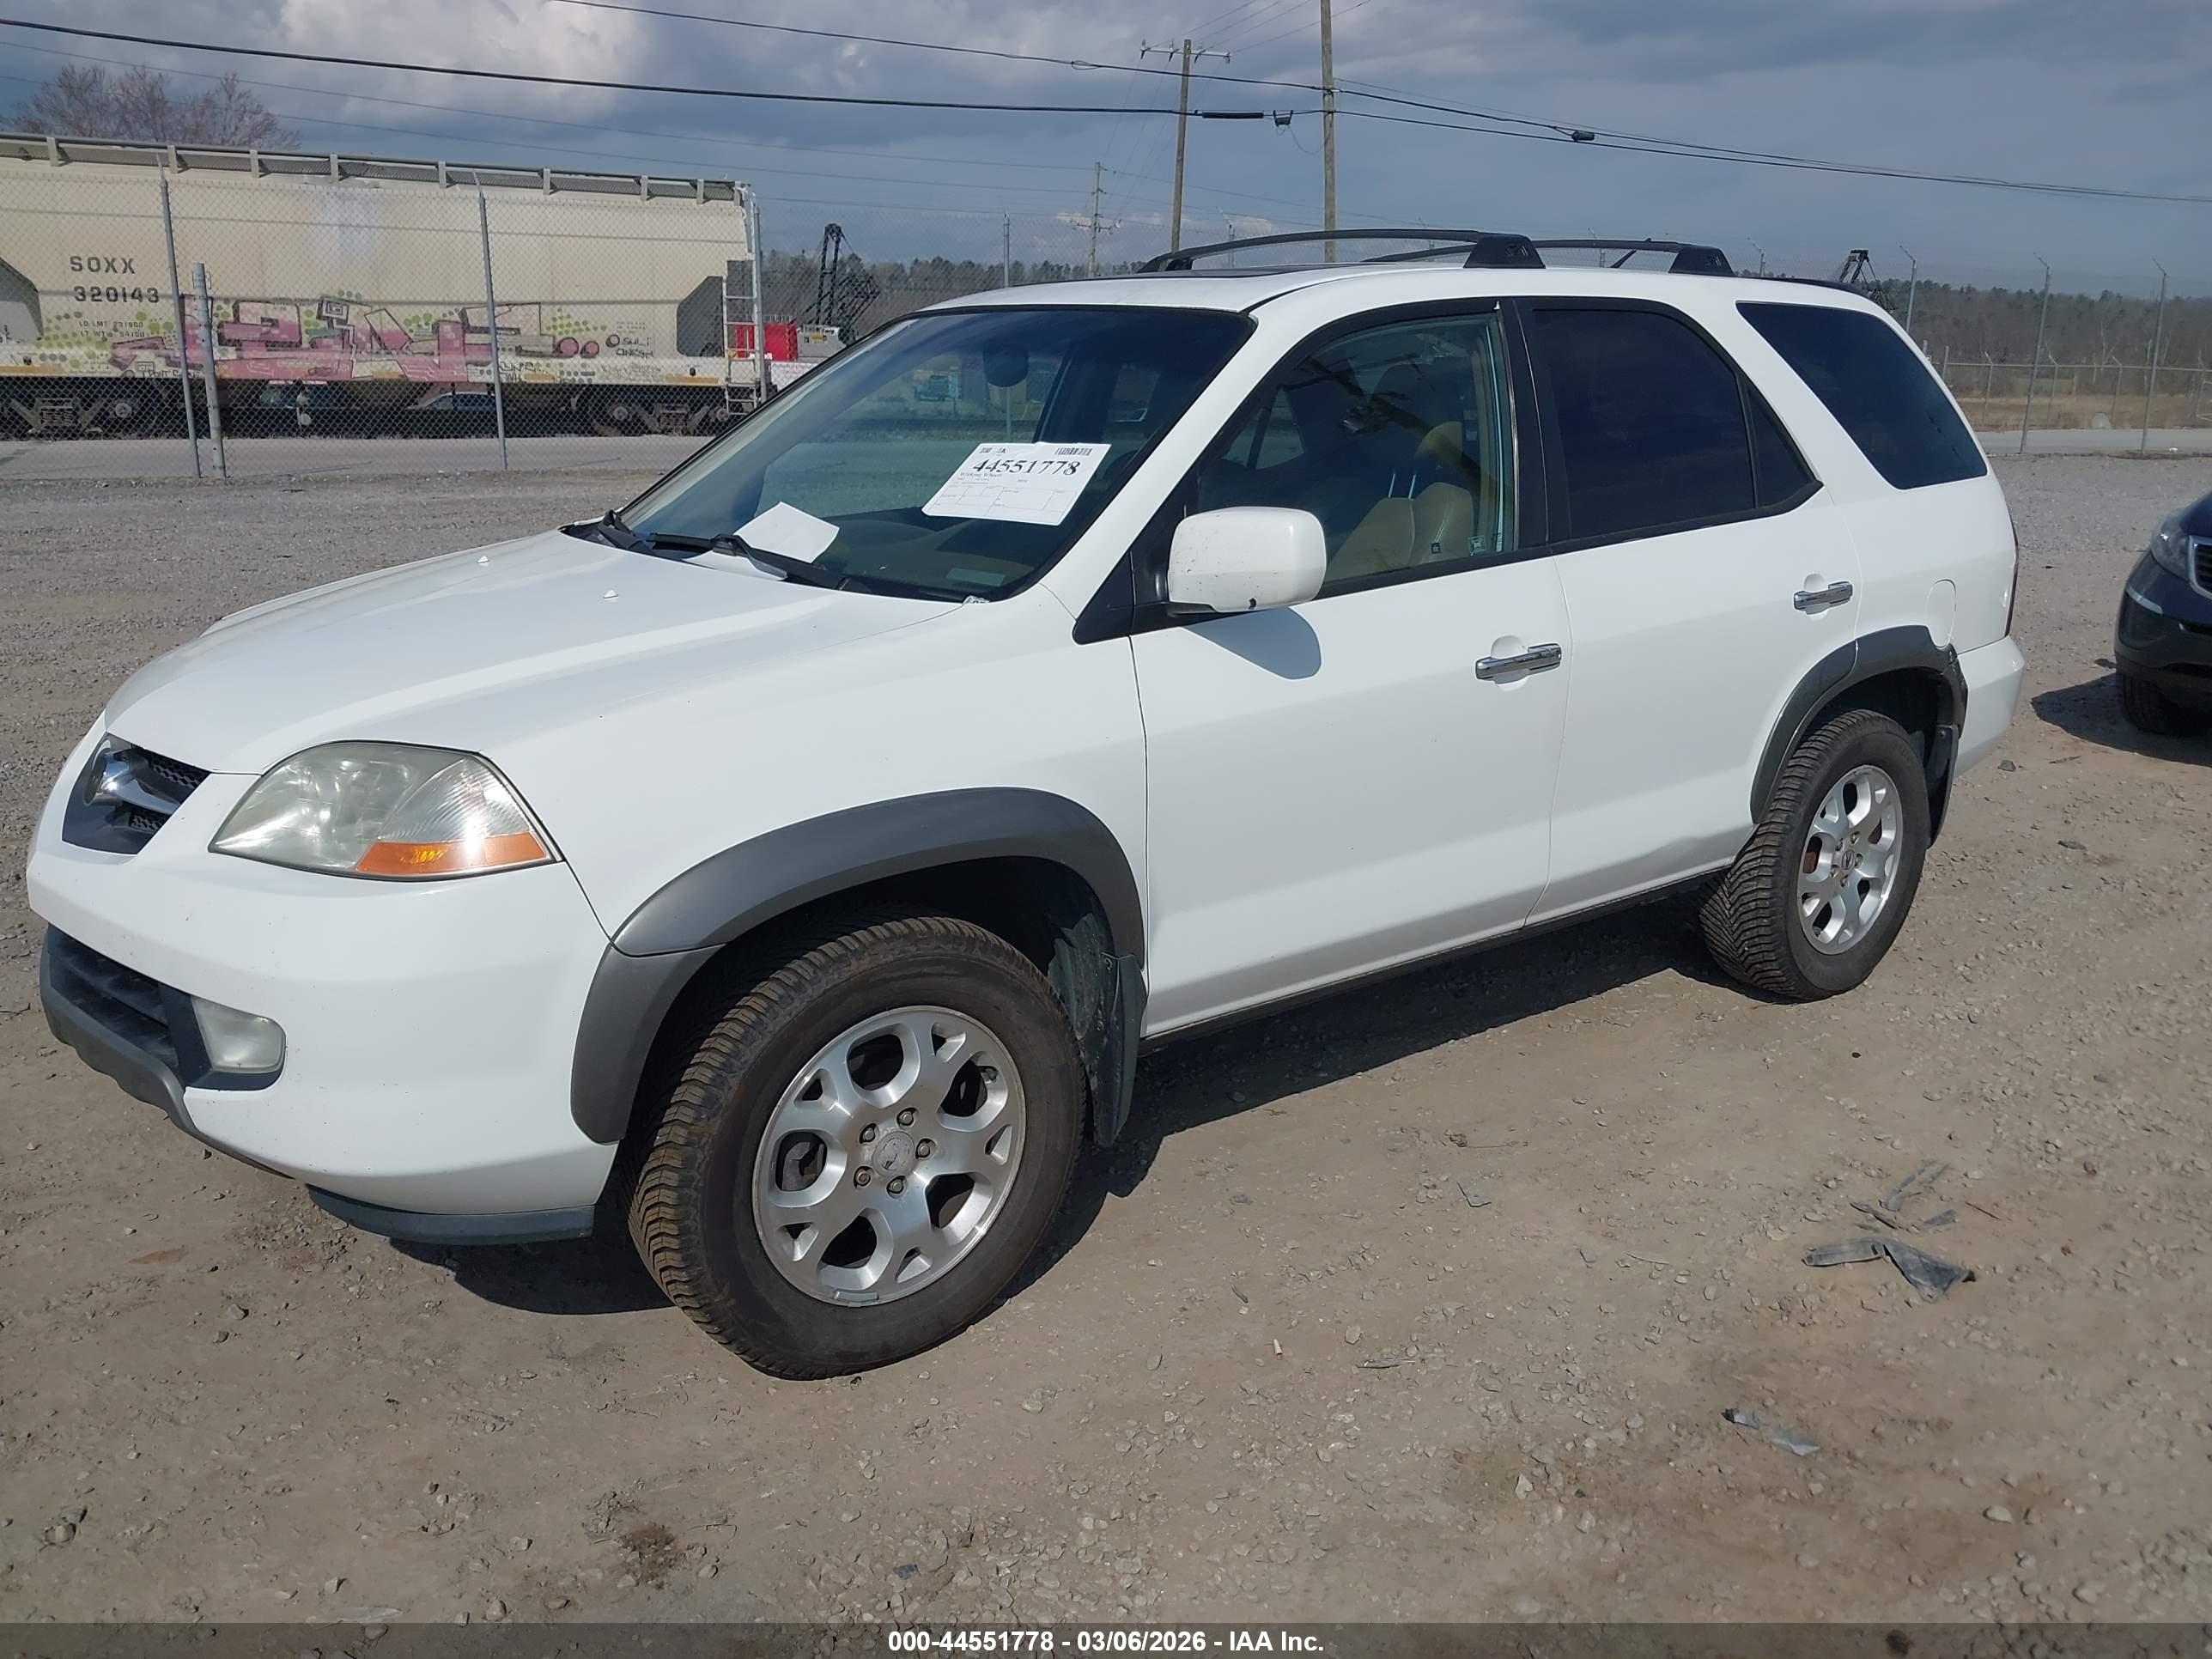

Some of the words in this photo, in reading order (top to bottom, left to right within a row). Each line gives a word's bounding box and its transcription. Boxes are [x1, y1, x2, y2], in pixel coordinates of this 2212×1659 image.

[70, 256, 136, 274] SOXX
[74, 286, 160, 303] 320143
[972, 458, 1081, 475] 44551778
